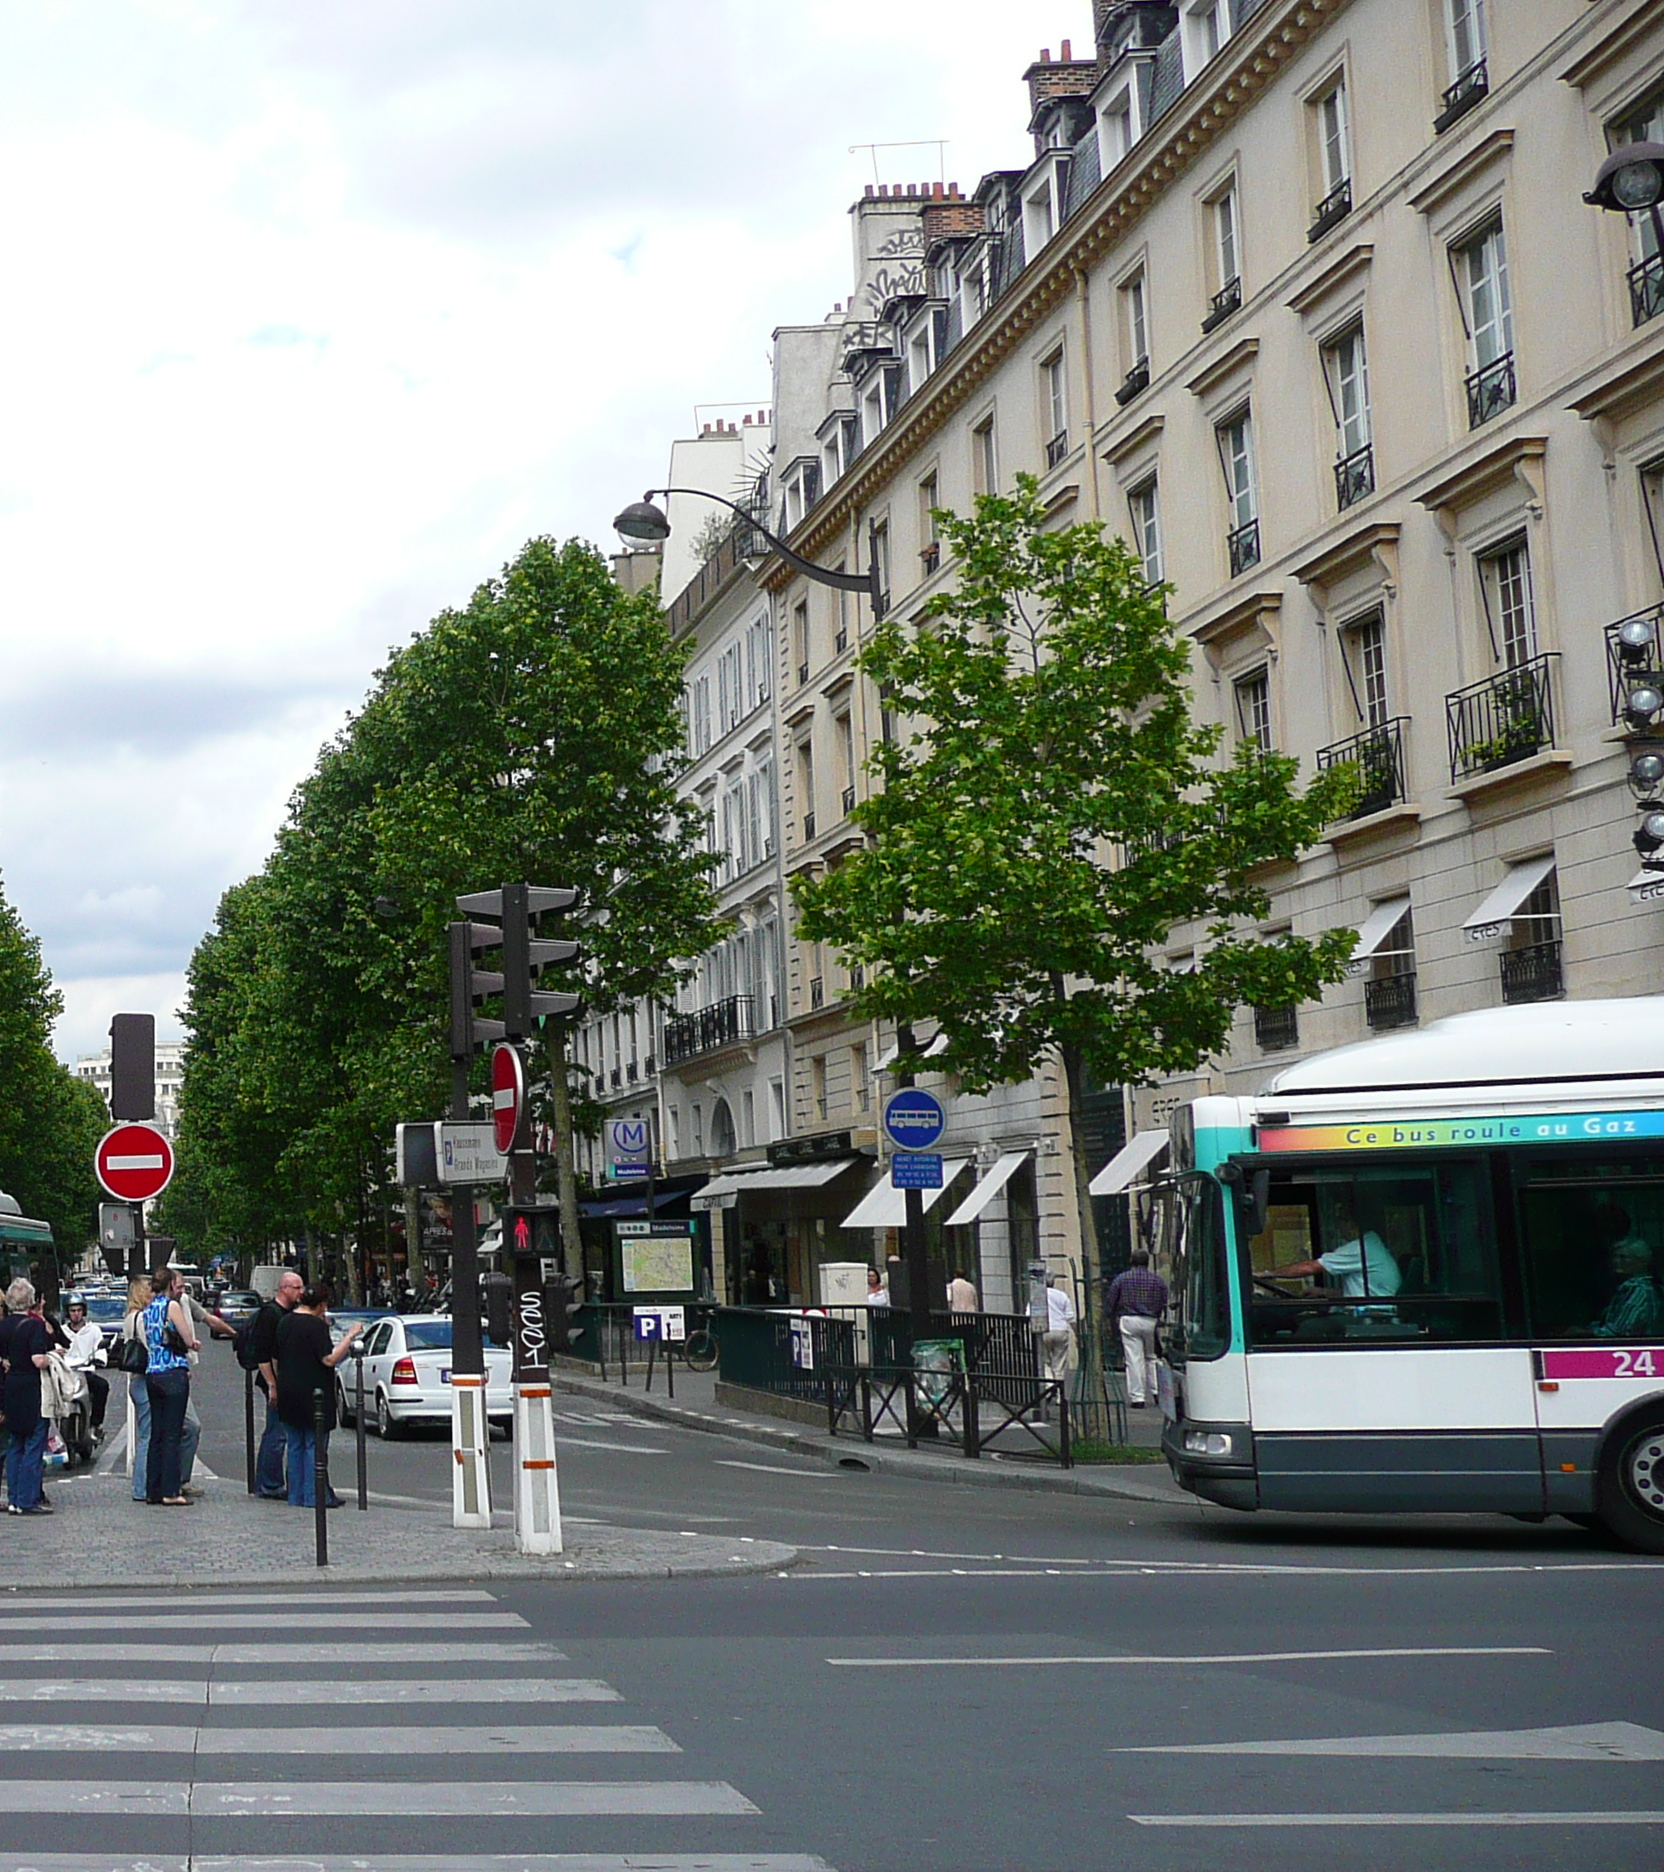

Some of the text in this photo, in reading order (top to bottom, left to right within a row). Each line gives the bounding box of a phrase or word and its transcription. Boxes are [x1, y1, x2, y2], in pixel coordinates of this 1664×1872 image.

[1346, 1117, 1637, 1144] Ce bus roule au Gaz
[640, 1317, 656, 1338] P
[1612, 1350, 1656, 1377] 24
